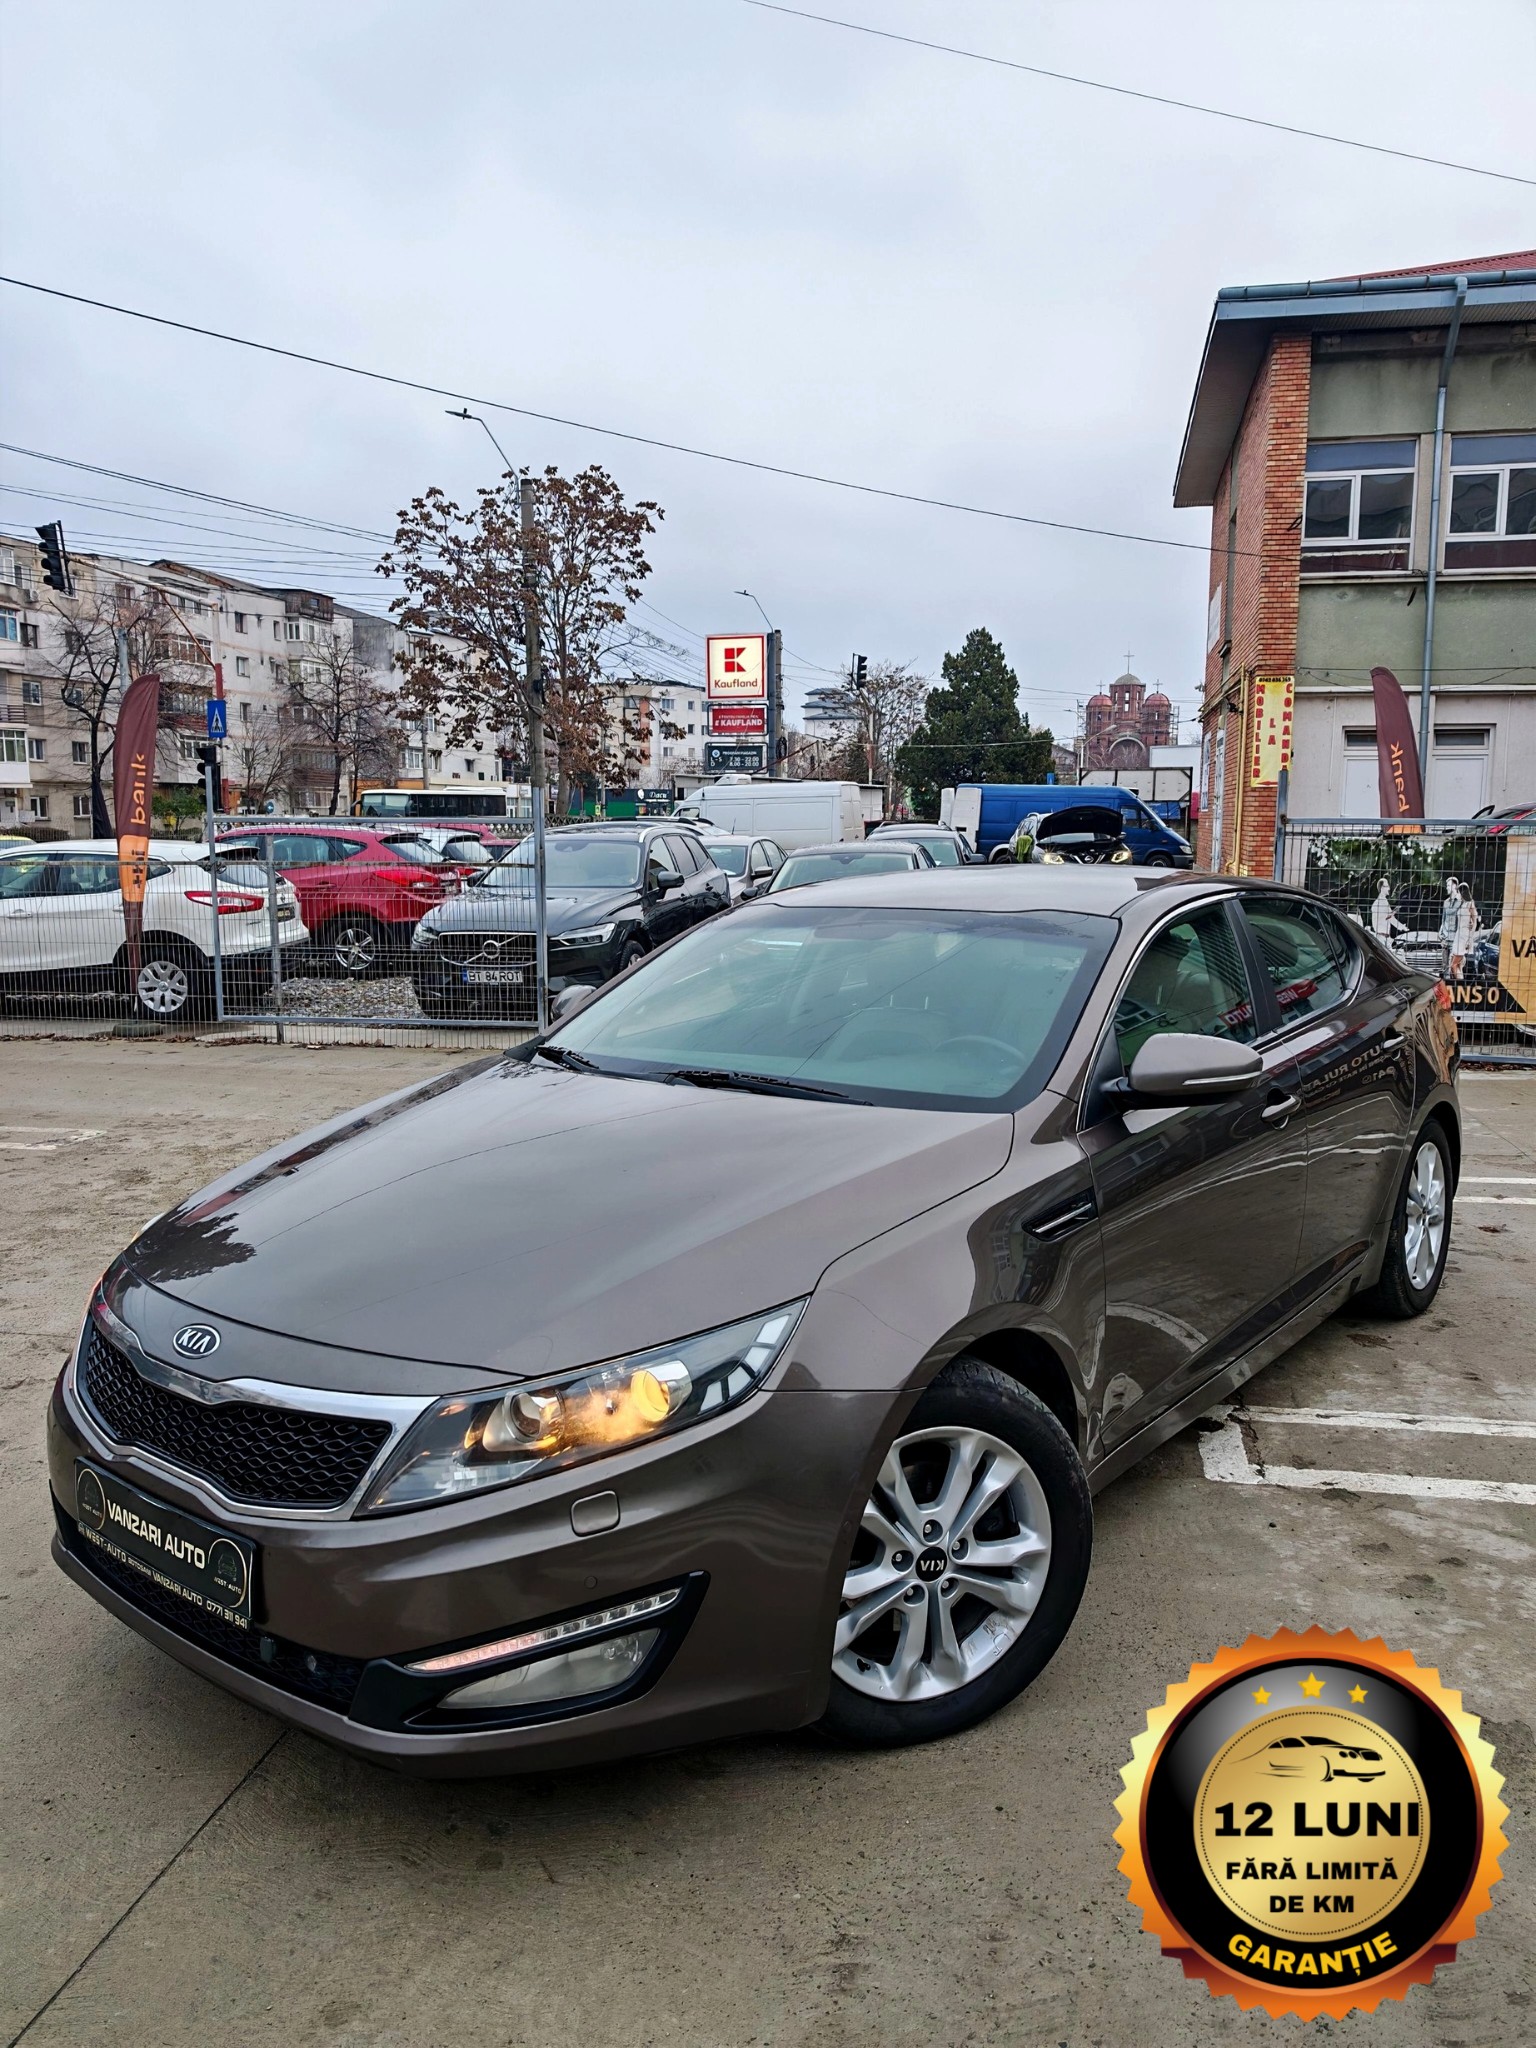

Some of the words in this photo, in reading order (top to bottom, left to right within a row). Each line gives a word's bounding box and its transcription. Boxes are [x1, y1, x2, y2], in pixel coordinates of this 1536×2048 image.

[714, 678, 758, 688] Kaufland
[721, 718, 763, 727] KAUFLAND
[1252, 684, 1265, 778] MOBILIER
[1267, 717, 1276, 745] LA
[130, 753, 146, 824] bank
[499, 971, 521, 981] ROT
[178, 1329, 211, 1353] KIA
[107, 1499, 161, 1548] VANZARI
[164, 1533, 205, 1569] AUTO
[920, 1559, 944, 1571] KIA
[152, 1570, 181, 1595] VANZARI
[182, 1588, 203, 1606] AUTO
[206, 1600, 223, 1616] 0771
[224, 1609, 234, 1621] 311
[234, 1615, 247, 1629] 941
